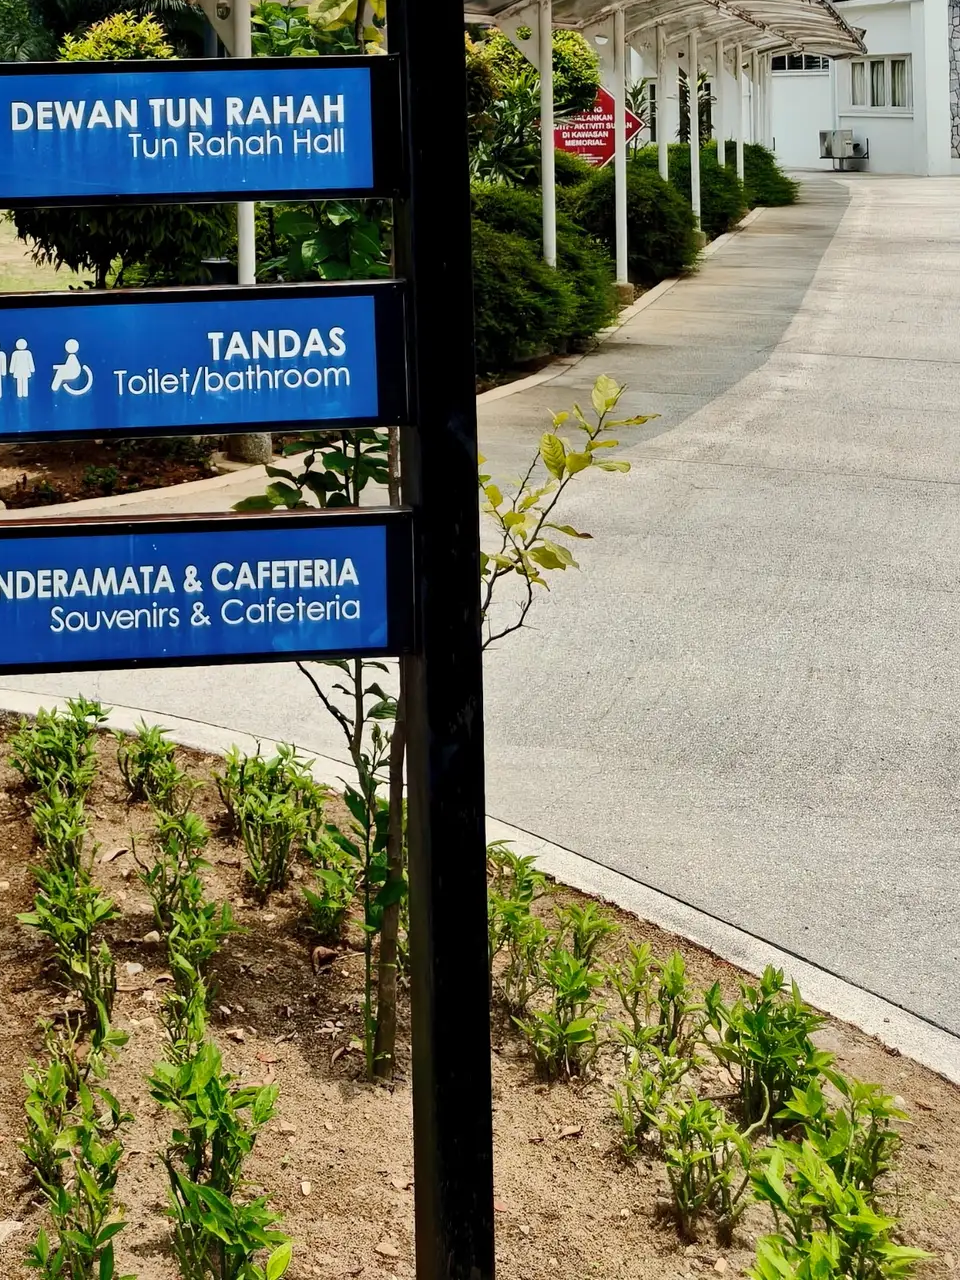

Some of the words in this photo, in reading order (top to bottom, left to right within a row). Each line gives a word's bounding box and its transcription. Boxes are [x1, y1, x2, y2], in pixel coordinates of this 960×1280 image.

[10, 98, 139, 131] DEWAN
[148, 96, 213, 127] TUN
[225, 94, 346, 124] RAHAH
[127, 133, 179, 159] Tun
[187, 129, 284, 157] Rahah
[292, 127, 345, 154] Hall
[571, 130, 609, 138] KAWASAN
[206, 326, 347, 361] TANDAS
[113, 364, 351, 397] Toilet/bathroom
[182, 564, 204, 592] &
[210, 557, 360, 591] CAFETERIA
[49, 601, 181, 633] Souvenirs
[189, 601, 213, 626] &
[220, 593, 361, 626] Cafeteria
